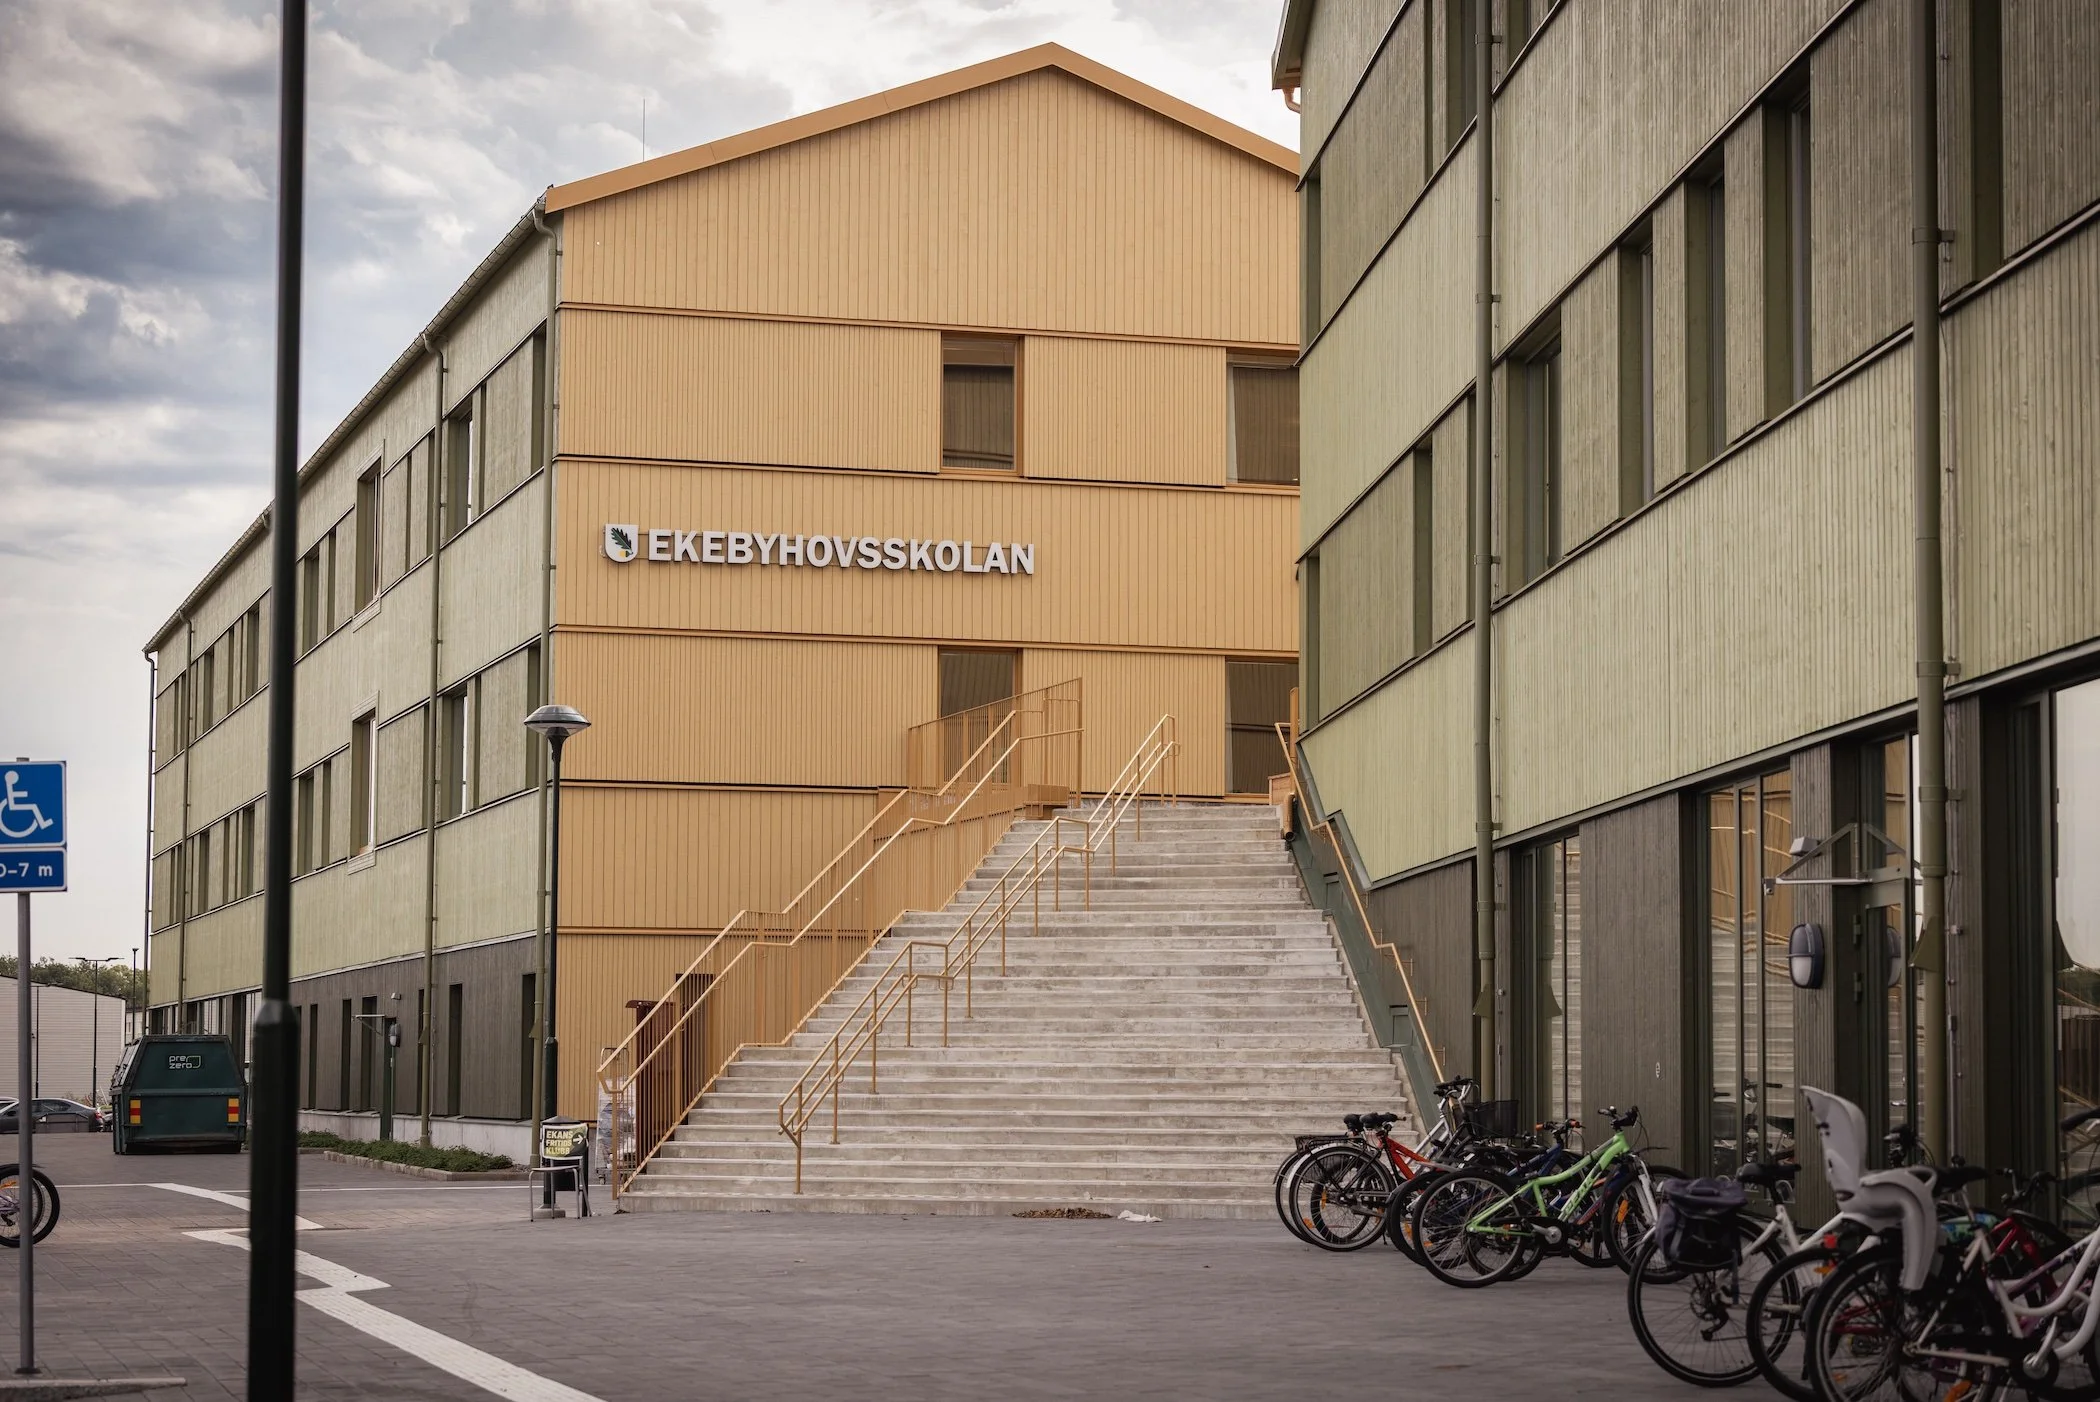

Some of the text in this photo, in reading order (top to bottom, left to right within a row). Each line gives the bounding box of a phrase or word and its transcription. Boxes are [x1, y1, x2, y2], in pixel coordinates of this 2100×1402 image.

[648, 528, 1035, 575] EKEBYHOVSSKOLAN
[38, 865, 53, 877] m
[169, 1055, 187, 1063] pre
[545, 1130, 574, 1139] EKANS
[545, 1139, 572, 1147] FRITIDS
[545, 1147, 571, 1155] KLUBB
